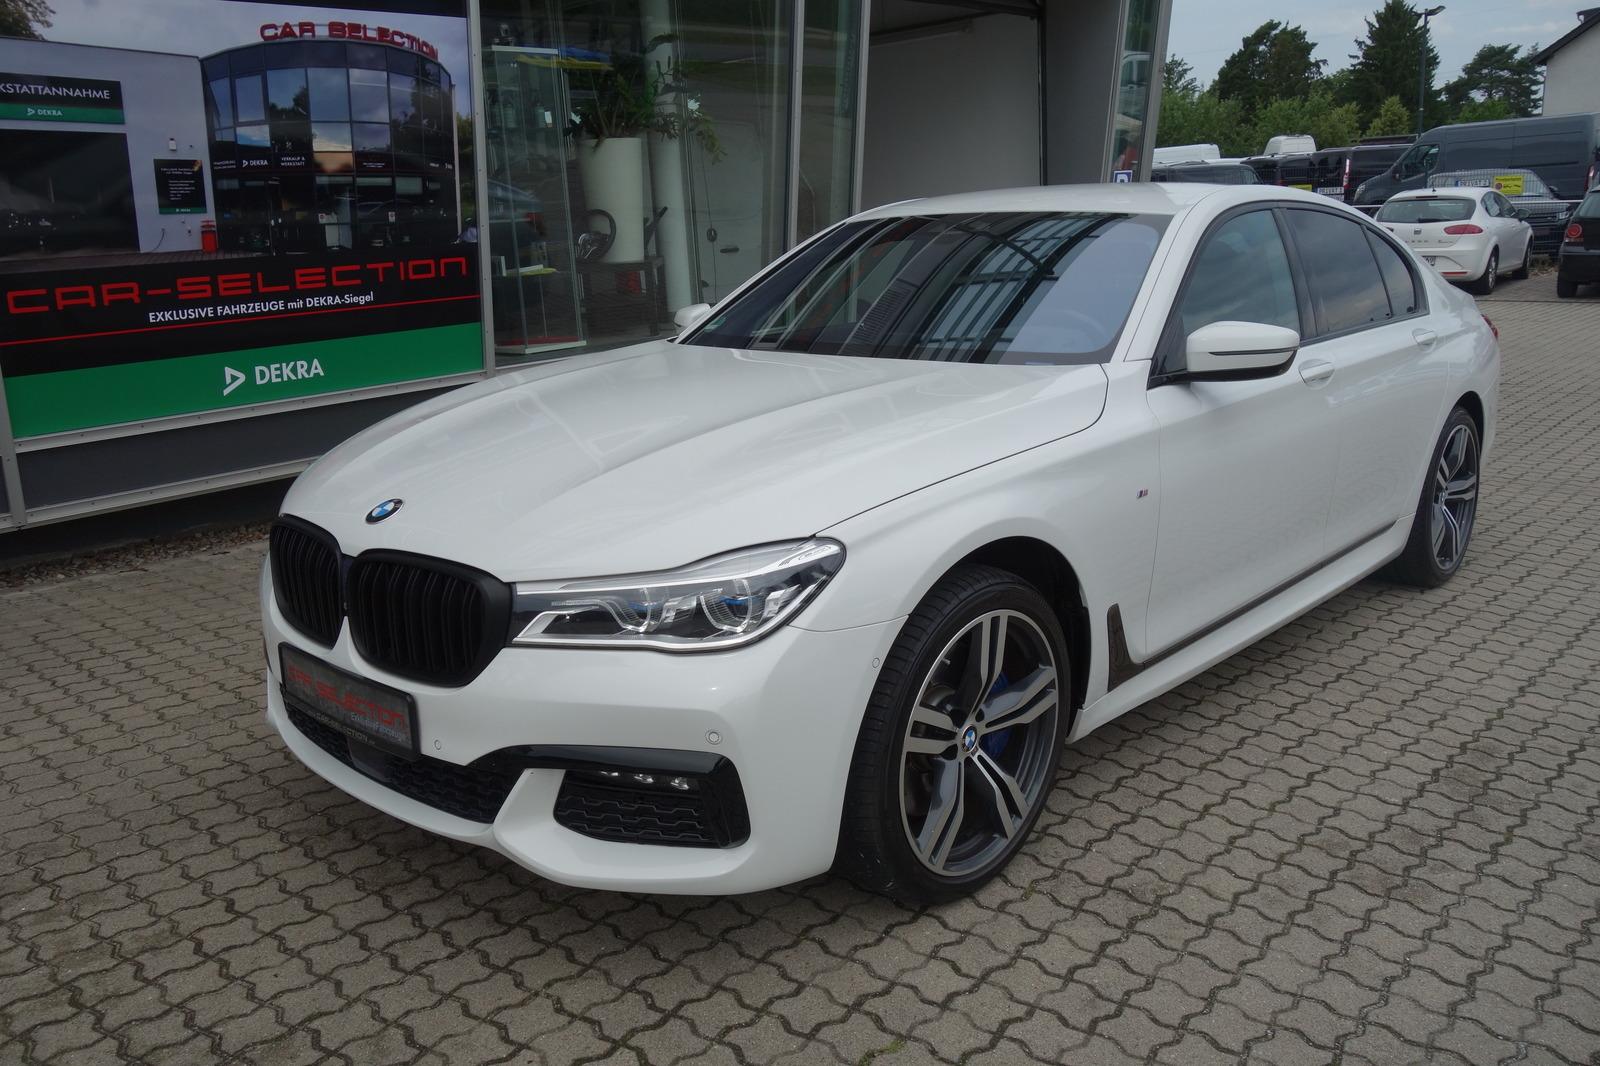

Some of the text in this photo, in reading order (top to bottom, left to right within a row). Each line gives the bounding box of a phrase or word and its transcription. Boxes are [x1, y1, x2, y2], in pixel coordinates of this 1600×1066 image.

[259, 21, 439, 60] CAR SELECTION
[7, 256, 468, 314] CAR-SELECTION
[149, 291, 374, 323] EXKLUSIVE FAHRZEUGE mit DEKRA-Siegel
[255, 358, 325, 385] DEKRA
